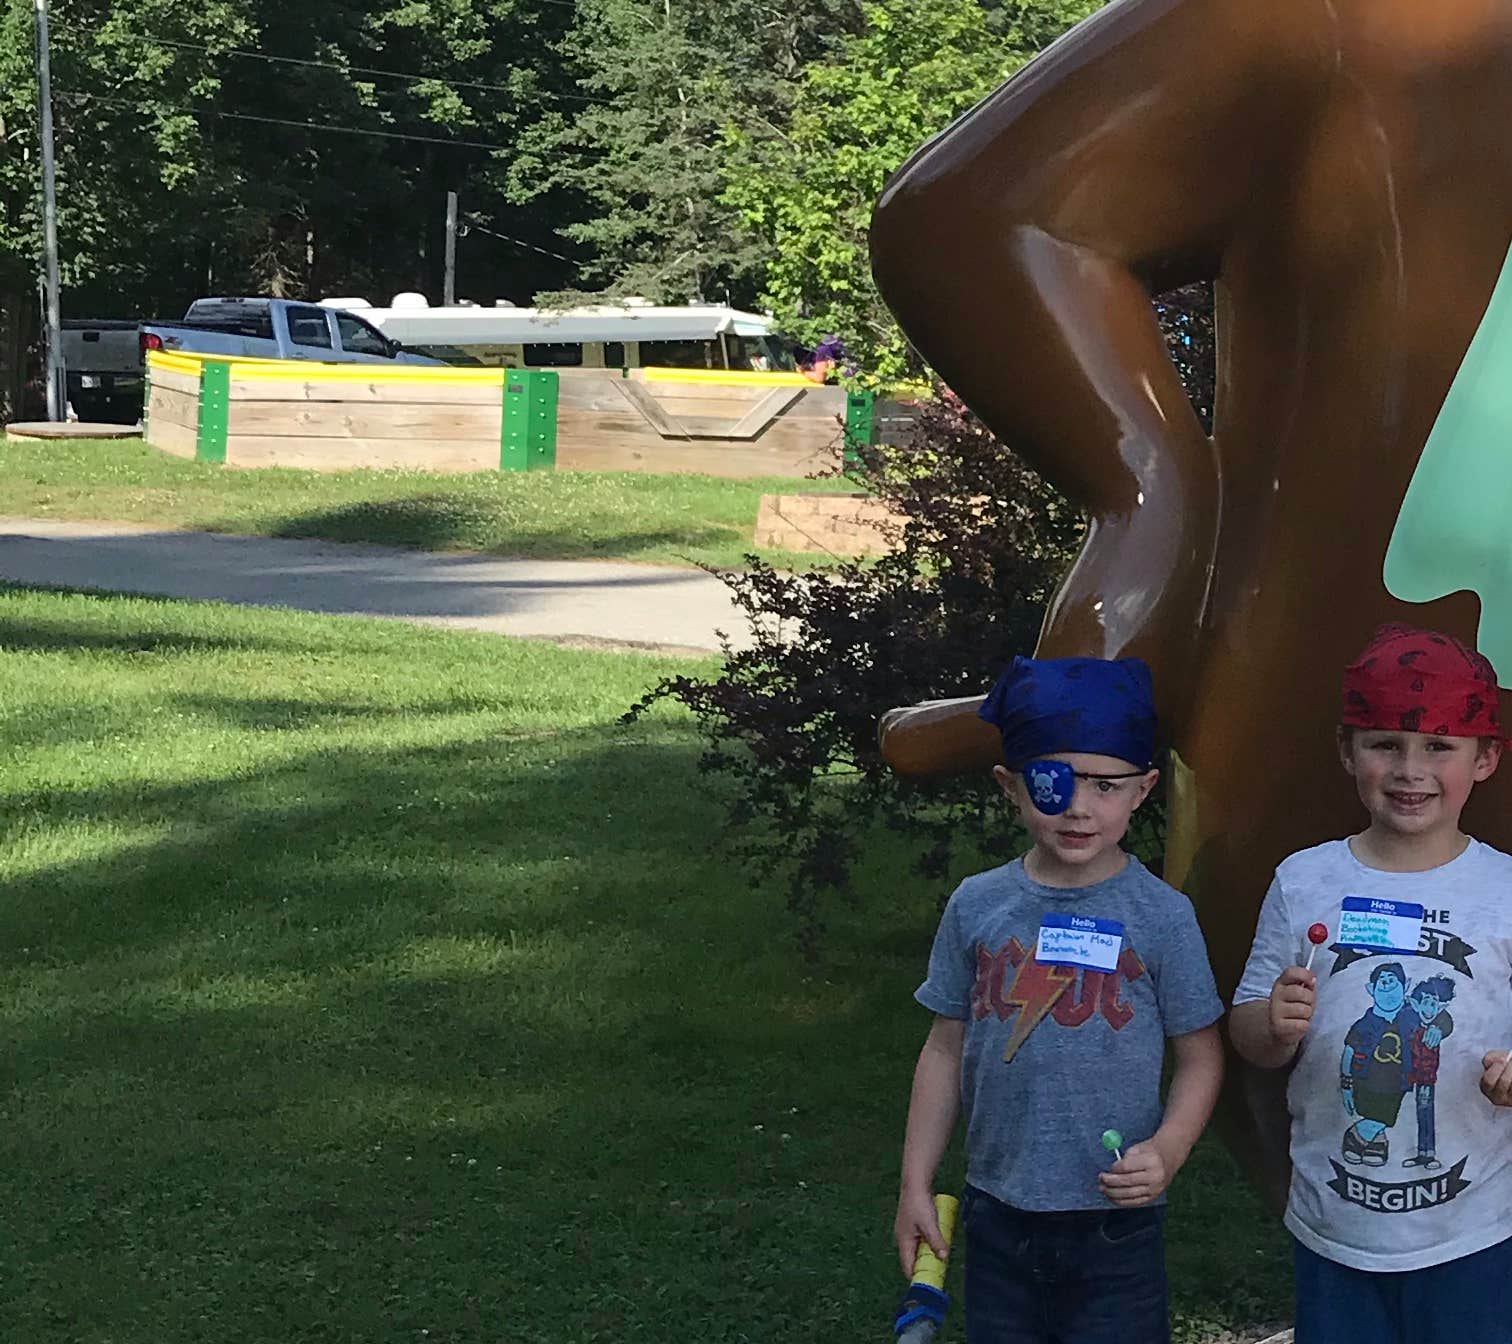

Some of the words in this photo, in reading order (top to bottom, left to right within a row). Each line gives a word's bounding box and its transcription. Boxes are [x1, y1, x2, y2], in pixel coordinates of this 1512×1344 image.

[1370, 900, 1396, 911] Hello
[1071, 917, 1096, 928] Hello
[1424, 909, 1450, 923] HE
[1373, 1031, 1402, 1064] Q
[1346, 1176, 1448, 1211] BEGIN!
